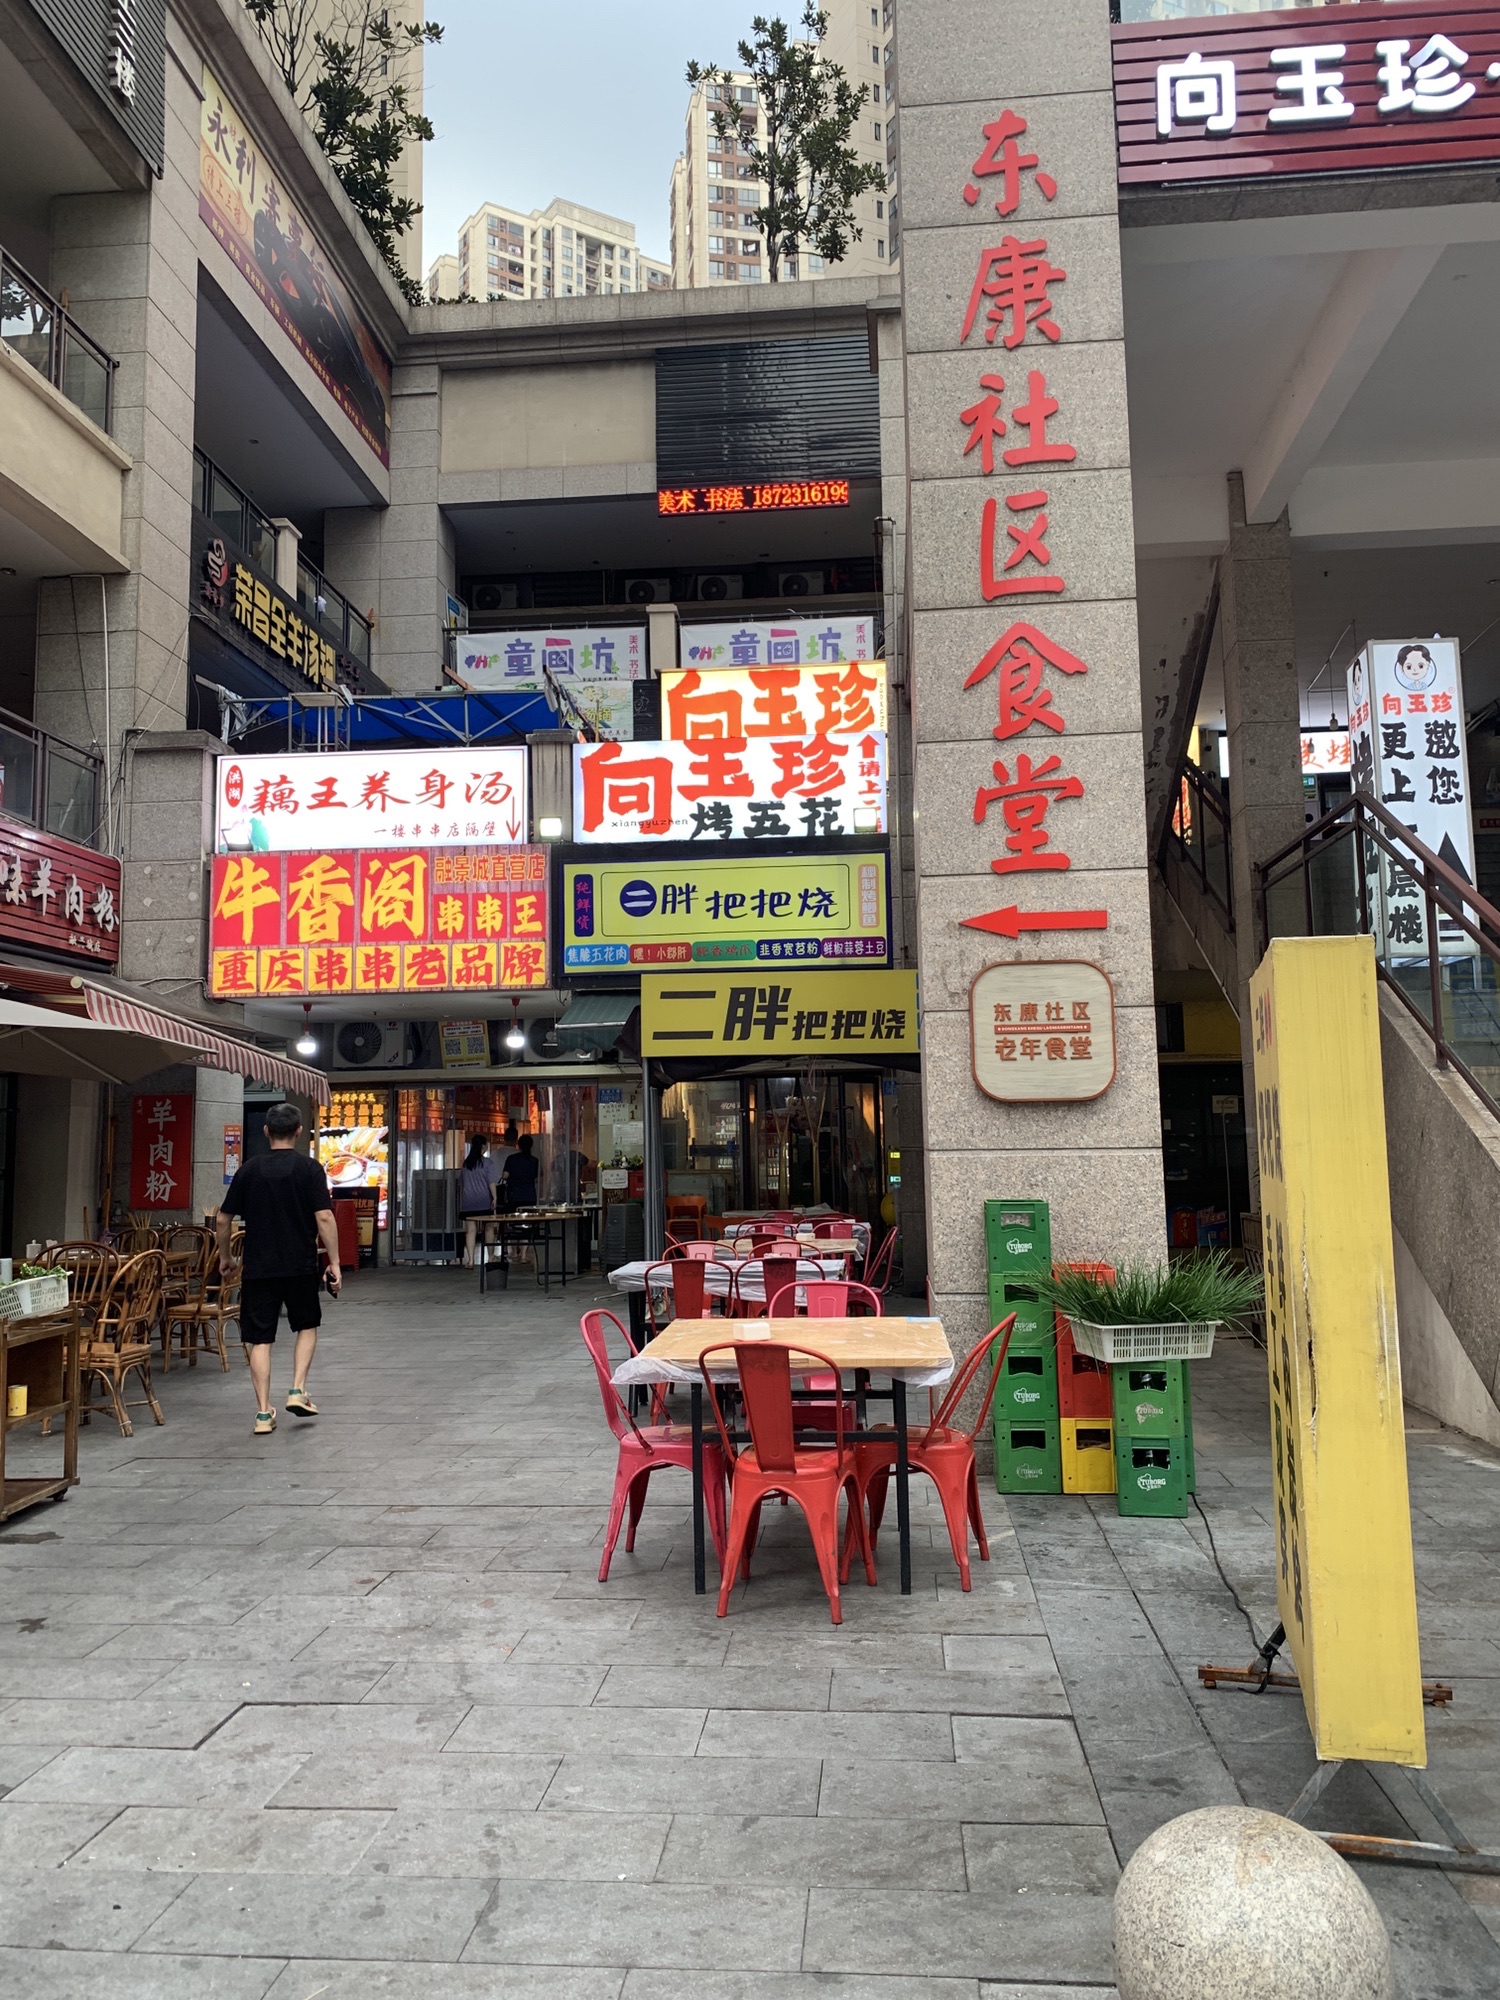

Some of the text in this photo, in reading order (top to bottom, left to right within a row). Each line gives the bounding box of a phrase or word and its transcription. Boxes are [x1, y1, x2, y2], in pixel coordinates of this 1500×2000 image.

[659, 489, 695, 513] 美术
[704, 487, 744, 511] 书法
[960, 109, 1088, 874] 东康社区食堂
[729, 627, 842, 667] 童画坊
[855, 624, 865, 644] 美术
[504, 637, 616, 677] 童画坊
[628, 634, 639, 679] 美术 书法
[666, 661, 878, 742] 向玉珍
[1349, 701, 1370, 735] 向玉珍
[1382, 693, 1453, 715] 向玉珍
[1424, 720, 1465, 805] 邀您
[228, 771, 241, 799] 洪湖
[248, 767, 513, 816] 藕王养身汤
[581, 734, 851, 835] 向玉珍
[856, 760, 883, 835] 请上二
[373, 820, 497, 840] 一楼串串店隔壁
[690, 797, 846, 840] 烤五花
[434, 853, 545, 884] 融景城直营店
[213, 854, 428, 945] 牛香阁
[436, 895, 545, 939] 串串王
[620, 880, 839, 920] 二胖把把烧
[217, 944, 544, 992] 重庆串串老品牌
[567, 946, 627, 964] 焦脆五花肉
[823, 940, 885, 956] 鲜椒蒜蓉土豆
[652, 985, 906, 1042] 二胖把把烧
[993, 1001, 1091, 1021] 东康社区
[995, 1036, 1092, 1061] 老年食堂
[143, 1098, 177, 1203] 羊肉粉
